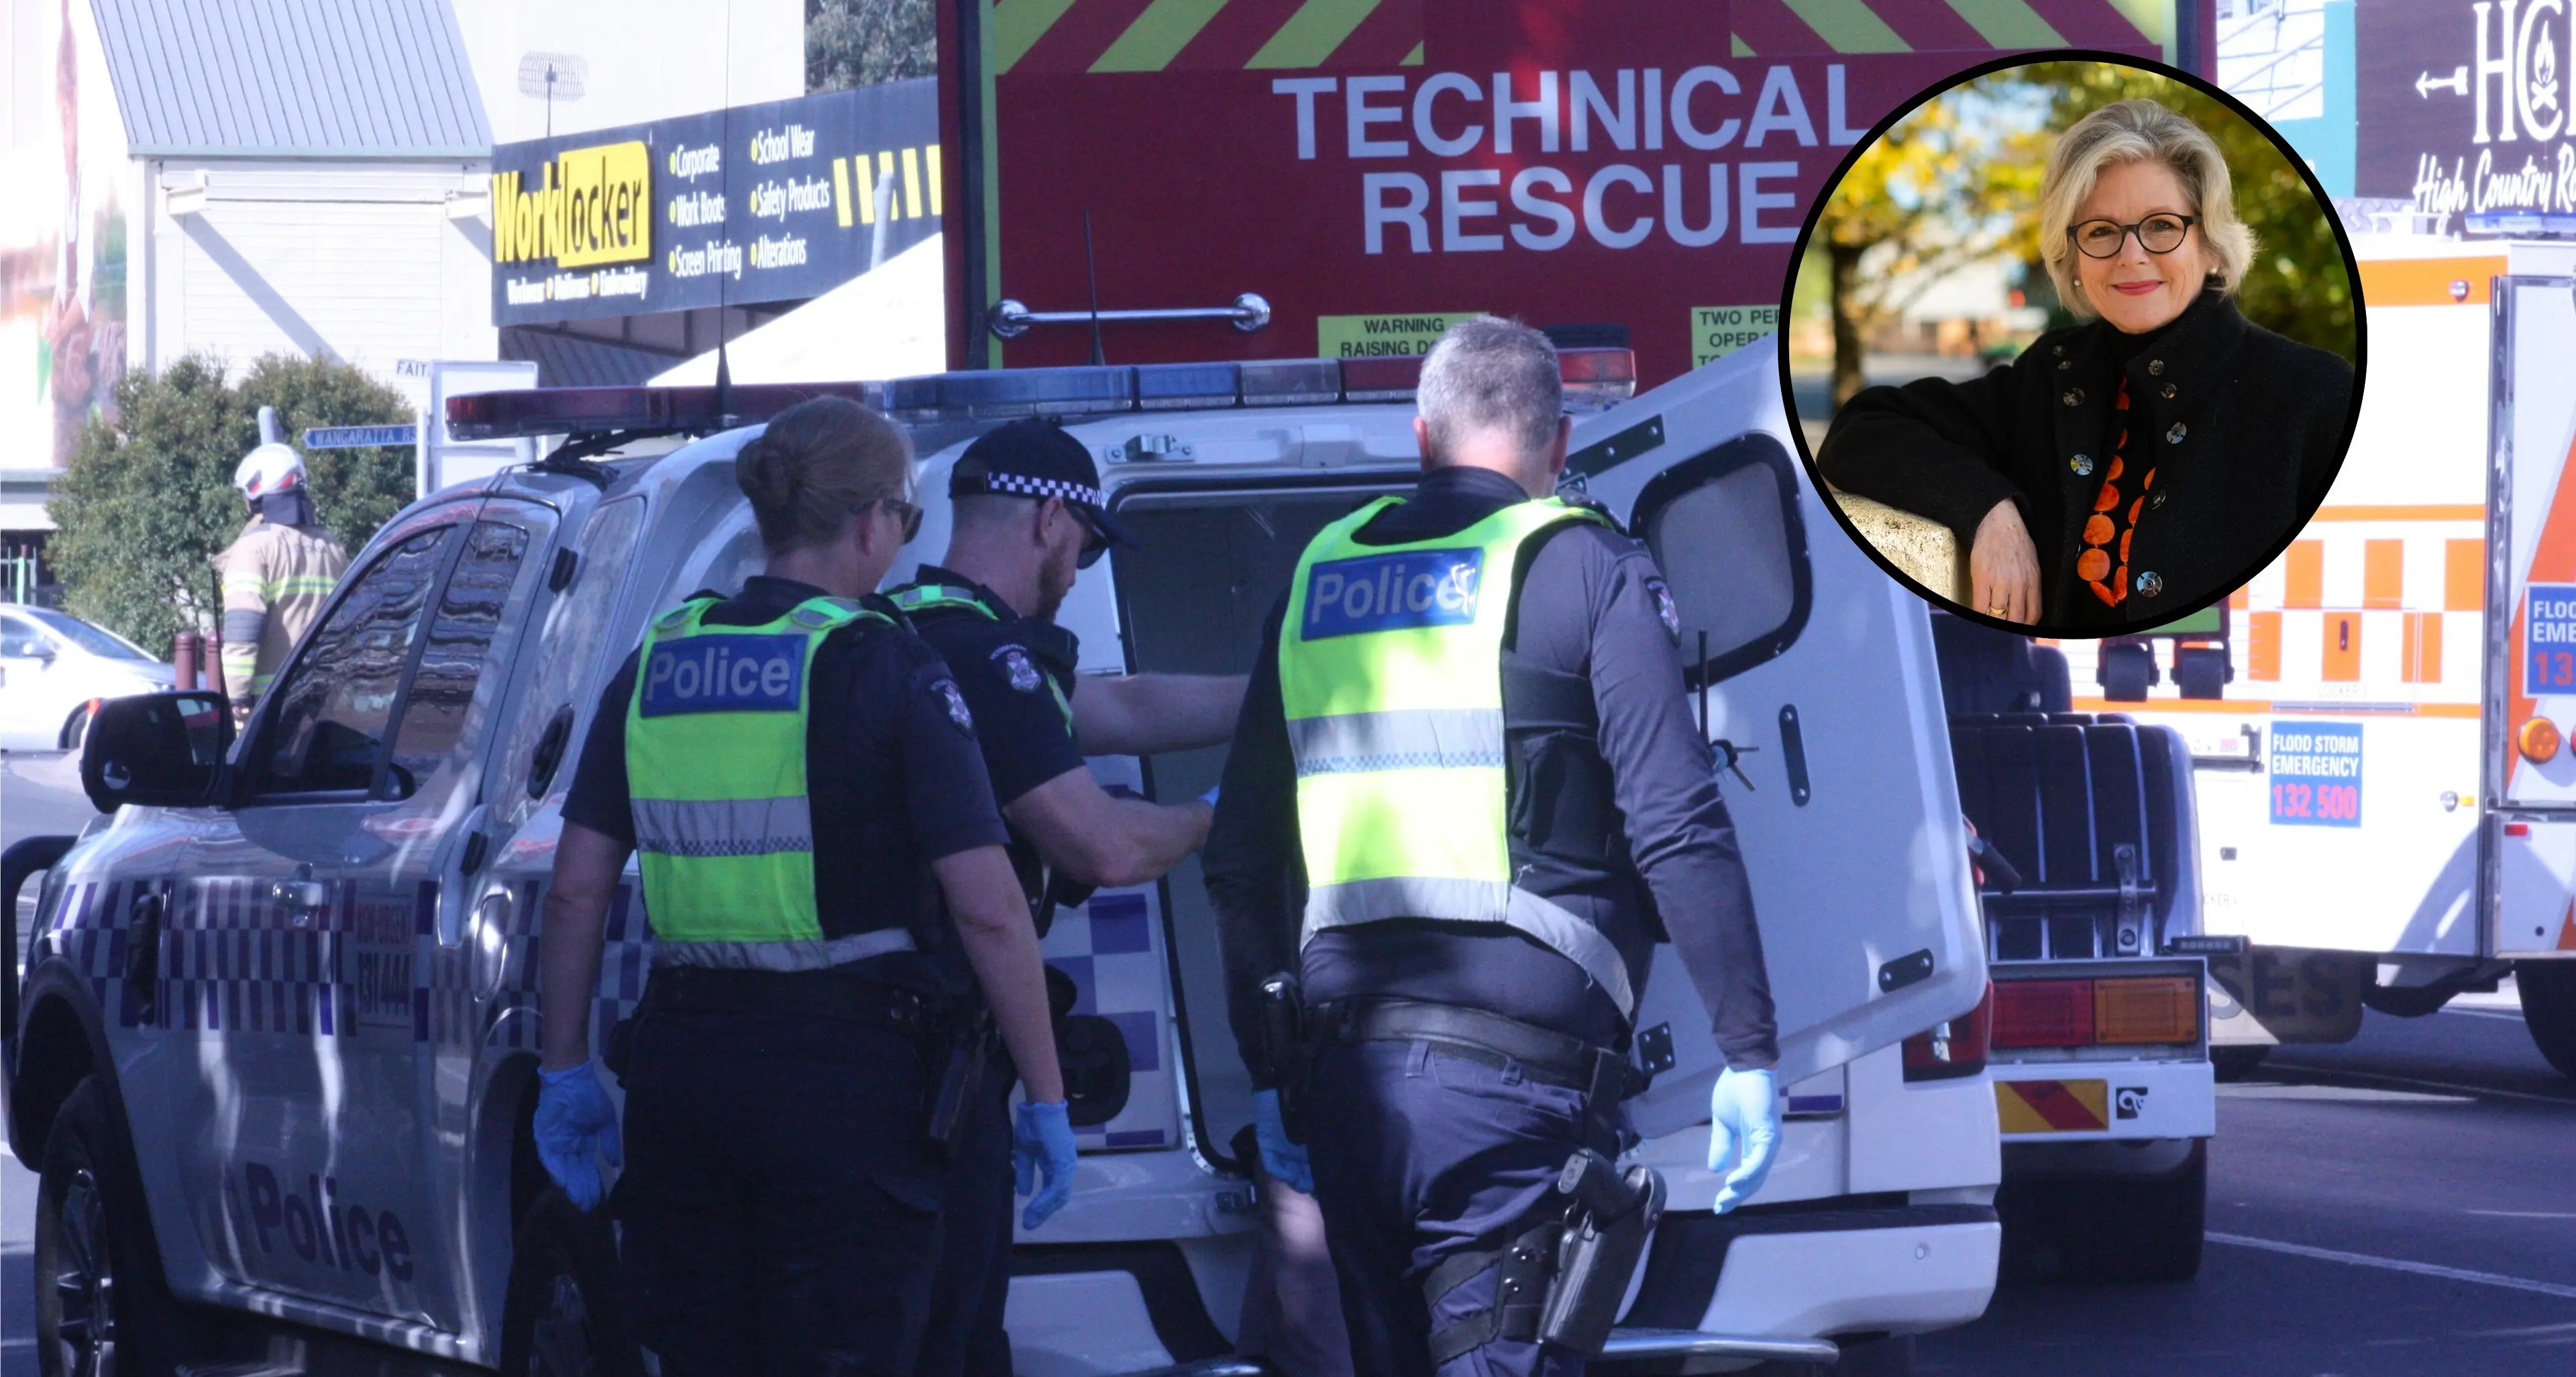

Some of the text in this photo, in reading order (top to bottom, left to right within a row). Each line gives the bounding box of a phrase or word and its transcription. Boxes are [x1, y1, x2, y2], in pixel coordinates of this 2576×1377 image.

[1273, 64, 1872, 160] TECHNICAL
[758, 124, 814, 165] School Wear
[676, 144, 720, 183] Corporate
[492, 155, 641, 262] Worklocker
[676, 190, 727, 227] Work Boots
[757, 174, 830, 223] Safety Products
[1363, 161, 1801, 254] RESCUE
[2413, 153, 2468, 237] High
[2473, 148, 2552, 213] Country
[676, 239, 742, 280] Screen Printing
[757, 232, 806, 269] Alterations
[1364, 319, 1444, 334] WARNING
[1699, 311, 1741, 325] TWO
[1340, 340, 1410, 357] RAISING
[1710, 333, 1769, 347] OPER
[397, 361, 430, 377] FAIT
[315, 427, 417, 446] WANGARATTA RS
[1310, 564, 1474, 624] Police
[646, 645, 790, 702] Police
[2534, 651, 2576, 685] 13
[2273, 734, 2359, 754] FLOOD STORM
[2272, 755, 2359, 777] EMERGENCY
[2274, 783, 2357, 819] 132 500
[246, 1162, 413, 1282] Police
